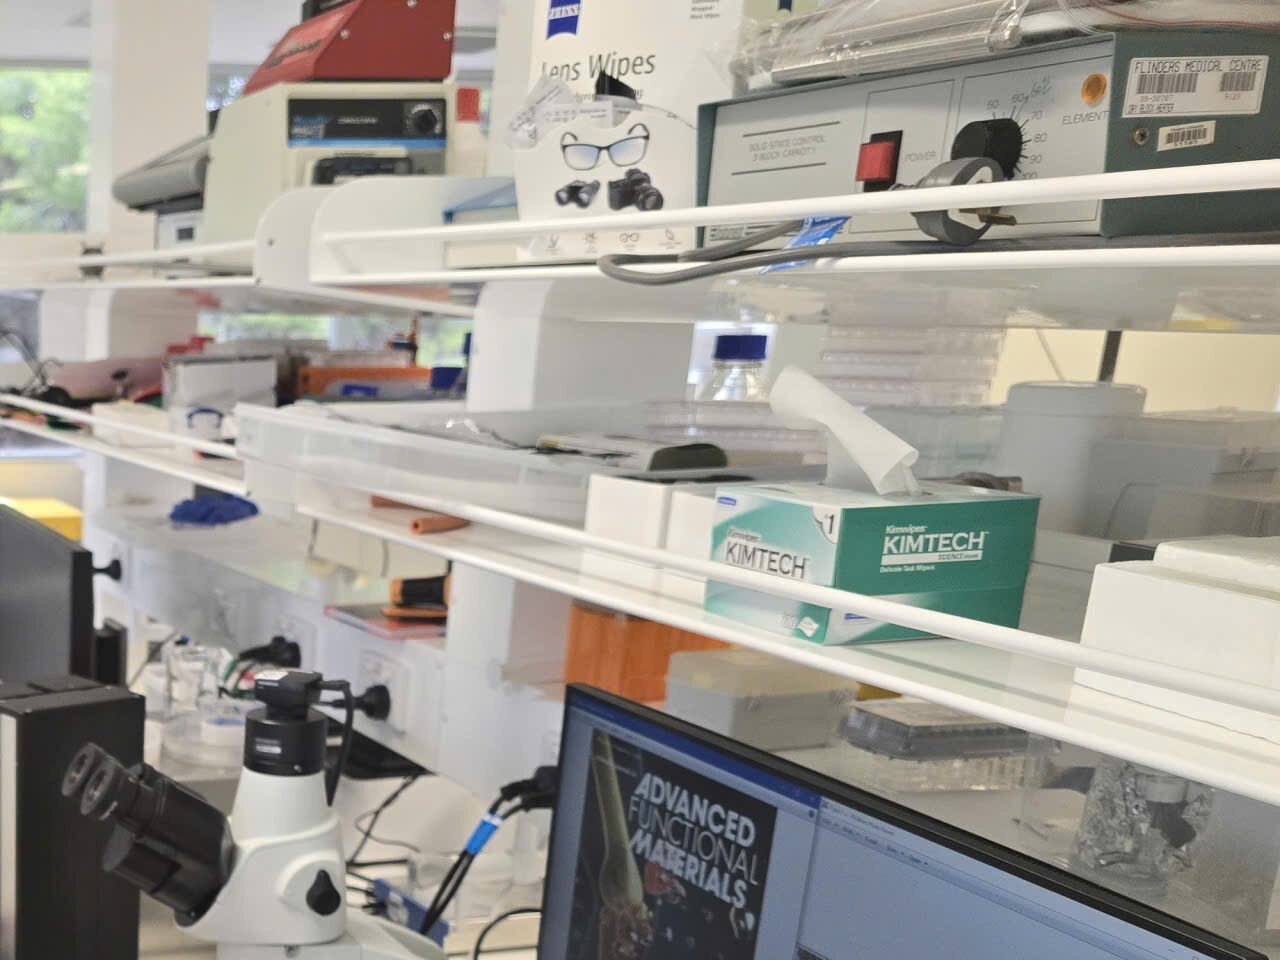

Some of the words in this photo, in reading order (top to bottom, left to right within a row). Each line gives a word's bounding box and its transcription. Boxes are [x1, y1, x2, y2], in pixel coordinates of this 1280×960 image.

[588, 52, 657, 80] Wipes
[1135, 61, 1180, 74] FLINDERS
[1184, 60, 1223, 73] MEDICAL
[1229, 59, 1262, 72] CENTRE
[1031, 110, 1042, 120] 70
[1062, 110, 1108, 125] ELEMENT
[1034, 133, 1047, 143] 80
[905, 151, 937, 162] POWER
[1030, 154, 1042, 165] 90
[883, 532, 984, 554] KIMTECH
[725, 541, 806, 579] KIMTECH
[635, 772, 756, 848] ADVANCED
[628, 795, 759, 886] FUNCTIONAL
[629, 828, 748, 909] MATERIALS
